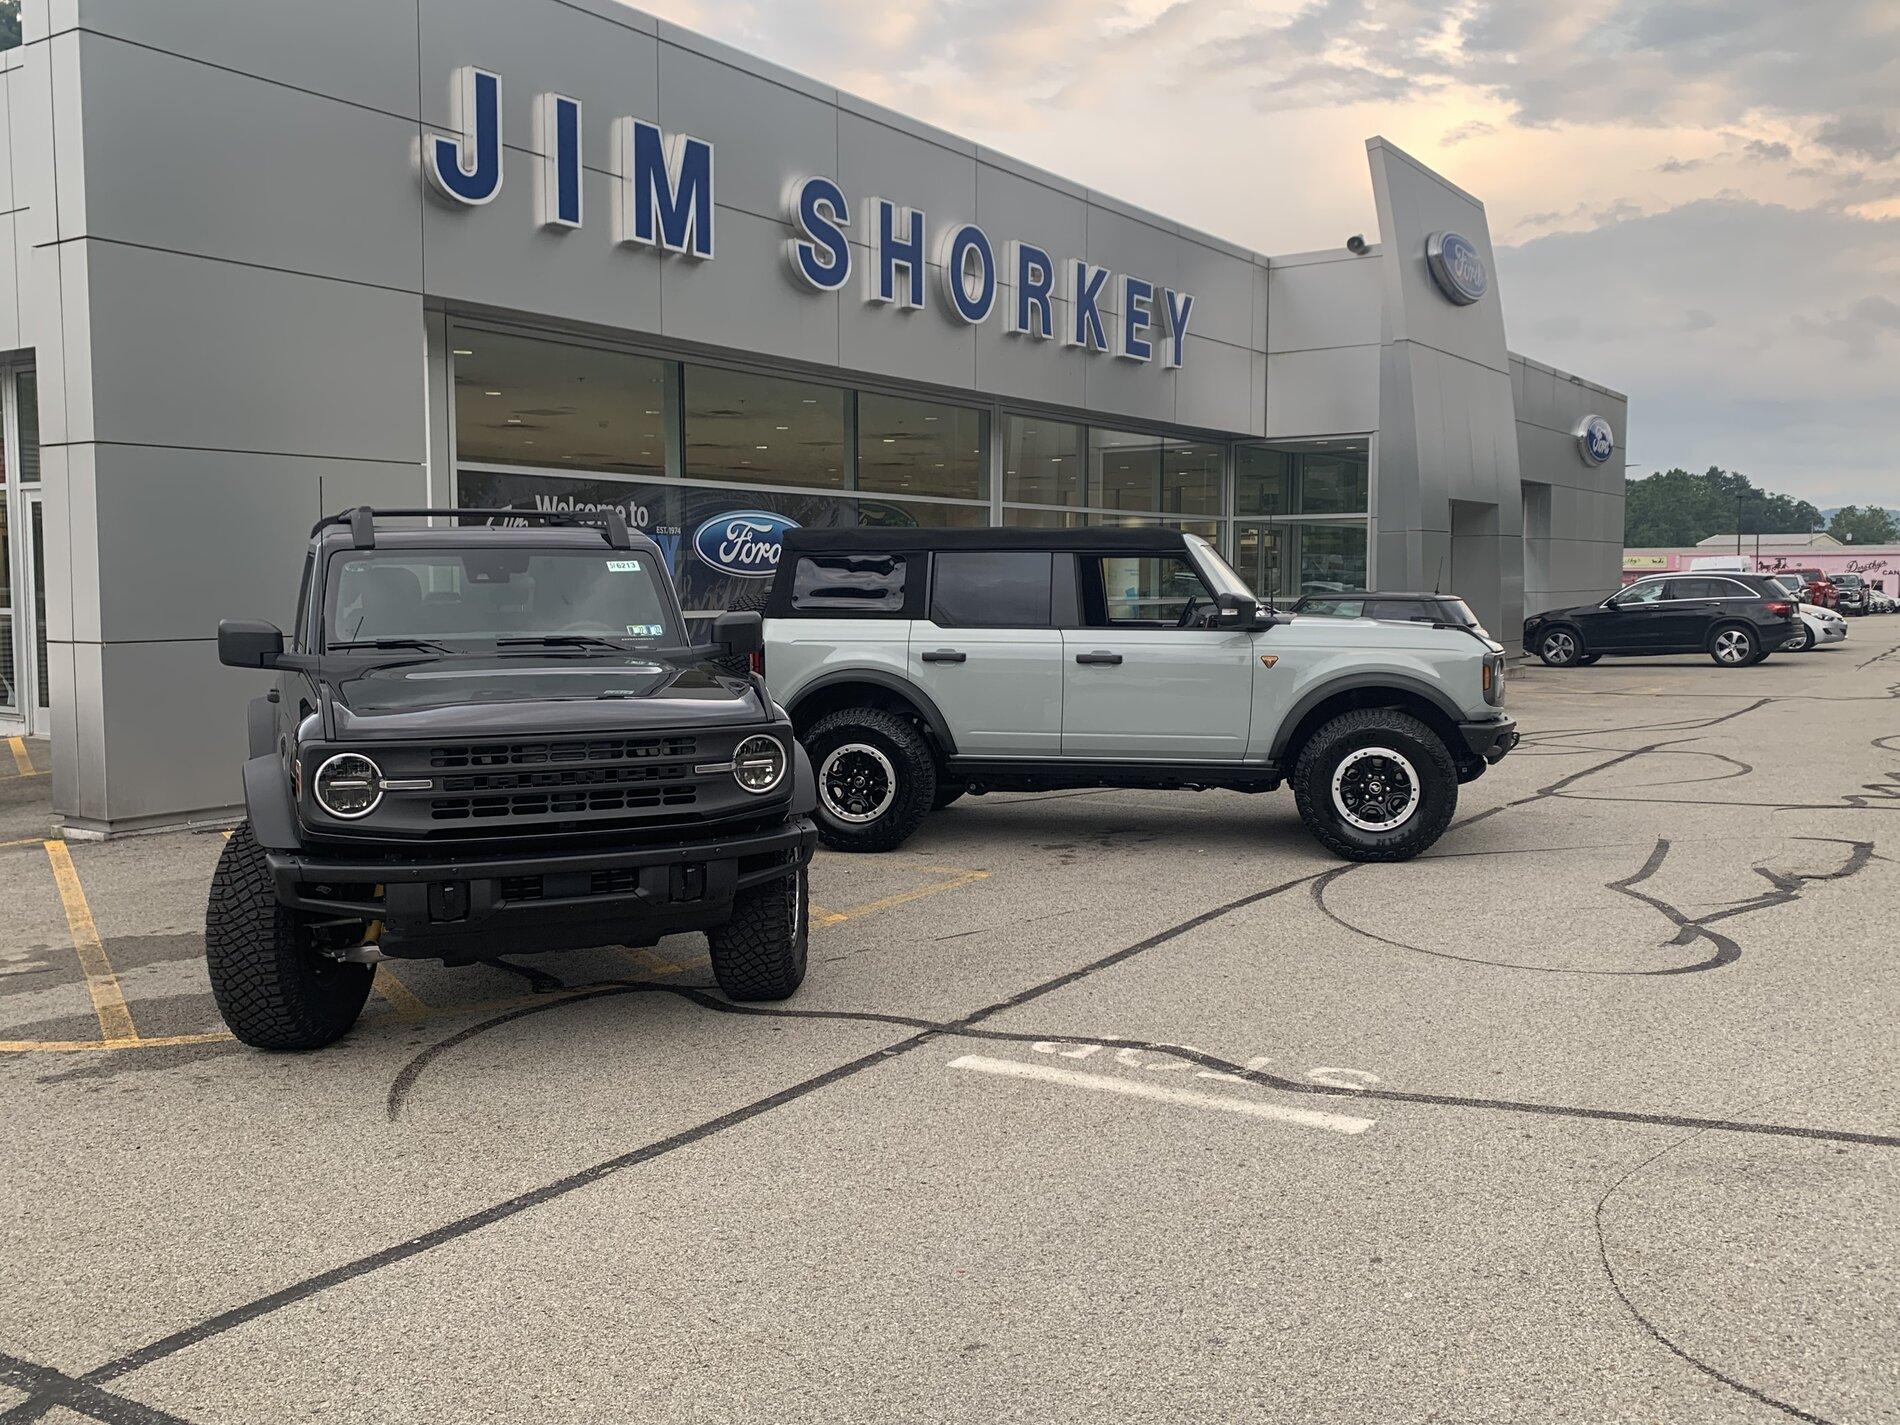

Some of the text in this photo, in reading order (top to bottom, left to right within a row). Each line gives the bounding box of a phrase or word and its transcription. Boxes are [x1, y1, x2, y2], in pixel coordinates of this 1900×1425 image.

[425, 65, 1195, 369] JIM SHORKEY
[1455, 244, 1482, 288] Ford
[629, 500, 649, 528] to
[668, 526, 681, 534] 1974
